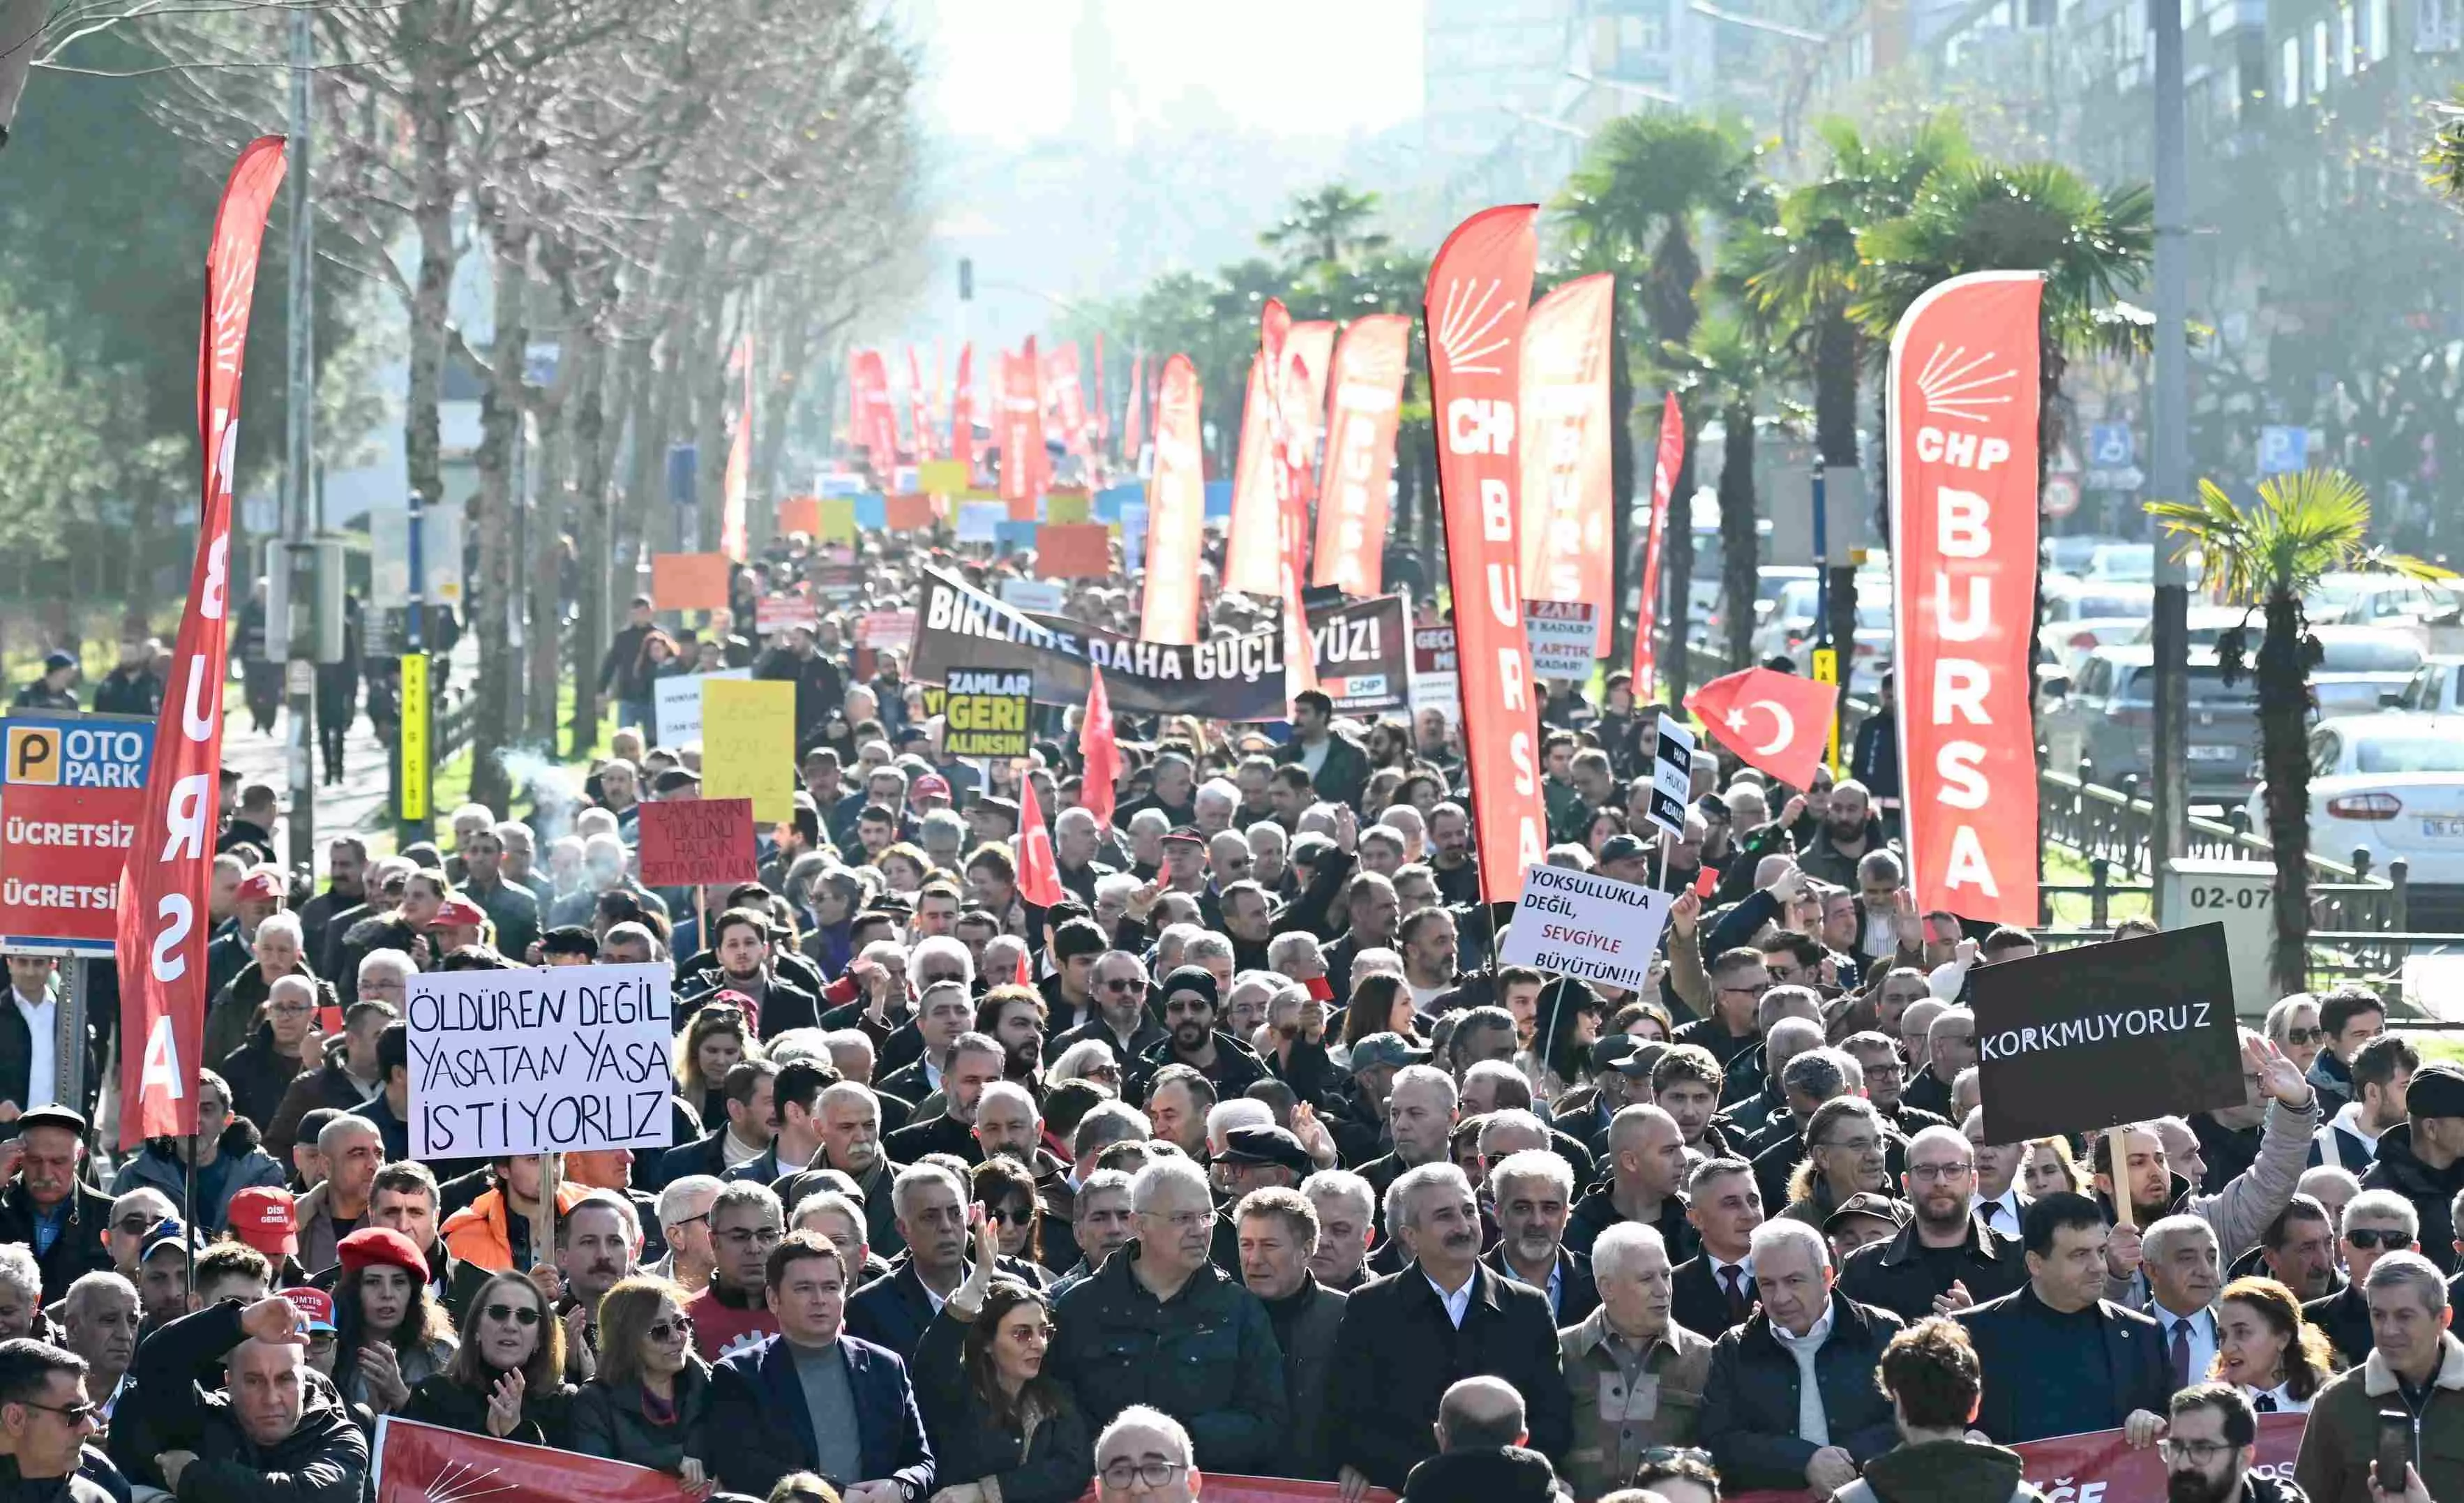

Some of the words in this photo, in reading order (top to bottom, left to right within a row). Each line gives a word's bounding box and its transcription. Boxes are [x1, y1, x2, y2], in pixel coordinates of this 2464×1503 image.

[1916, 426, 2011, 471] CHP
[1088, 637, 1182, 681] DAHA
[947, 673, 1032, 696] ZAMLAR
[1480, 479, 1545, 877] BURSA
[1932, 486, 1999, 898] BURSA
[947, 695, 1026, 731] GERİ
[66, 731, 143, 761] OTO
[66, 764, 142, 788] PARK
[6, 816, 135, 846] ÜCRETSİZ
[3, 878, 119, 908] ÜCRETSİ
[1524, 893, 1577, 920] DEĞİL,
[1532, 869, 1649, 910] YOKSULLUKLA
[2191, 887, 2271, 909] 02-07
[1541, 923, 1623, 954] SEVGİYLE
[1535, 951, 1642, 986] BÜYÜTÜN!!!
[409, 987, 566, 1032] ÖLDÜREN
[580, 977, 670, 1026] DEĞİL
[1980, 1002, 2211, 1062] KORKMUYORUZ
[573, 1029, 670, 1083] YASA
[423, 1091, 663, 1155] İSTİYORUZ
